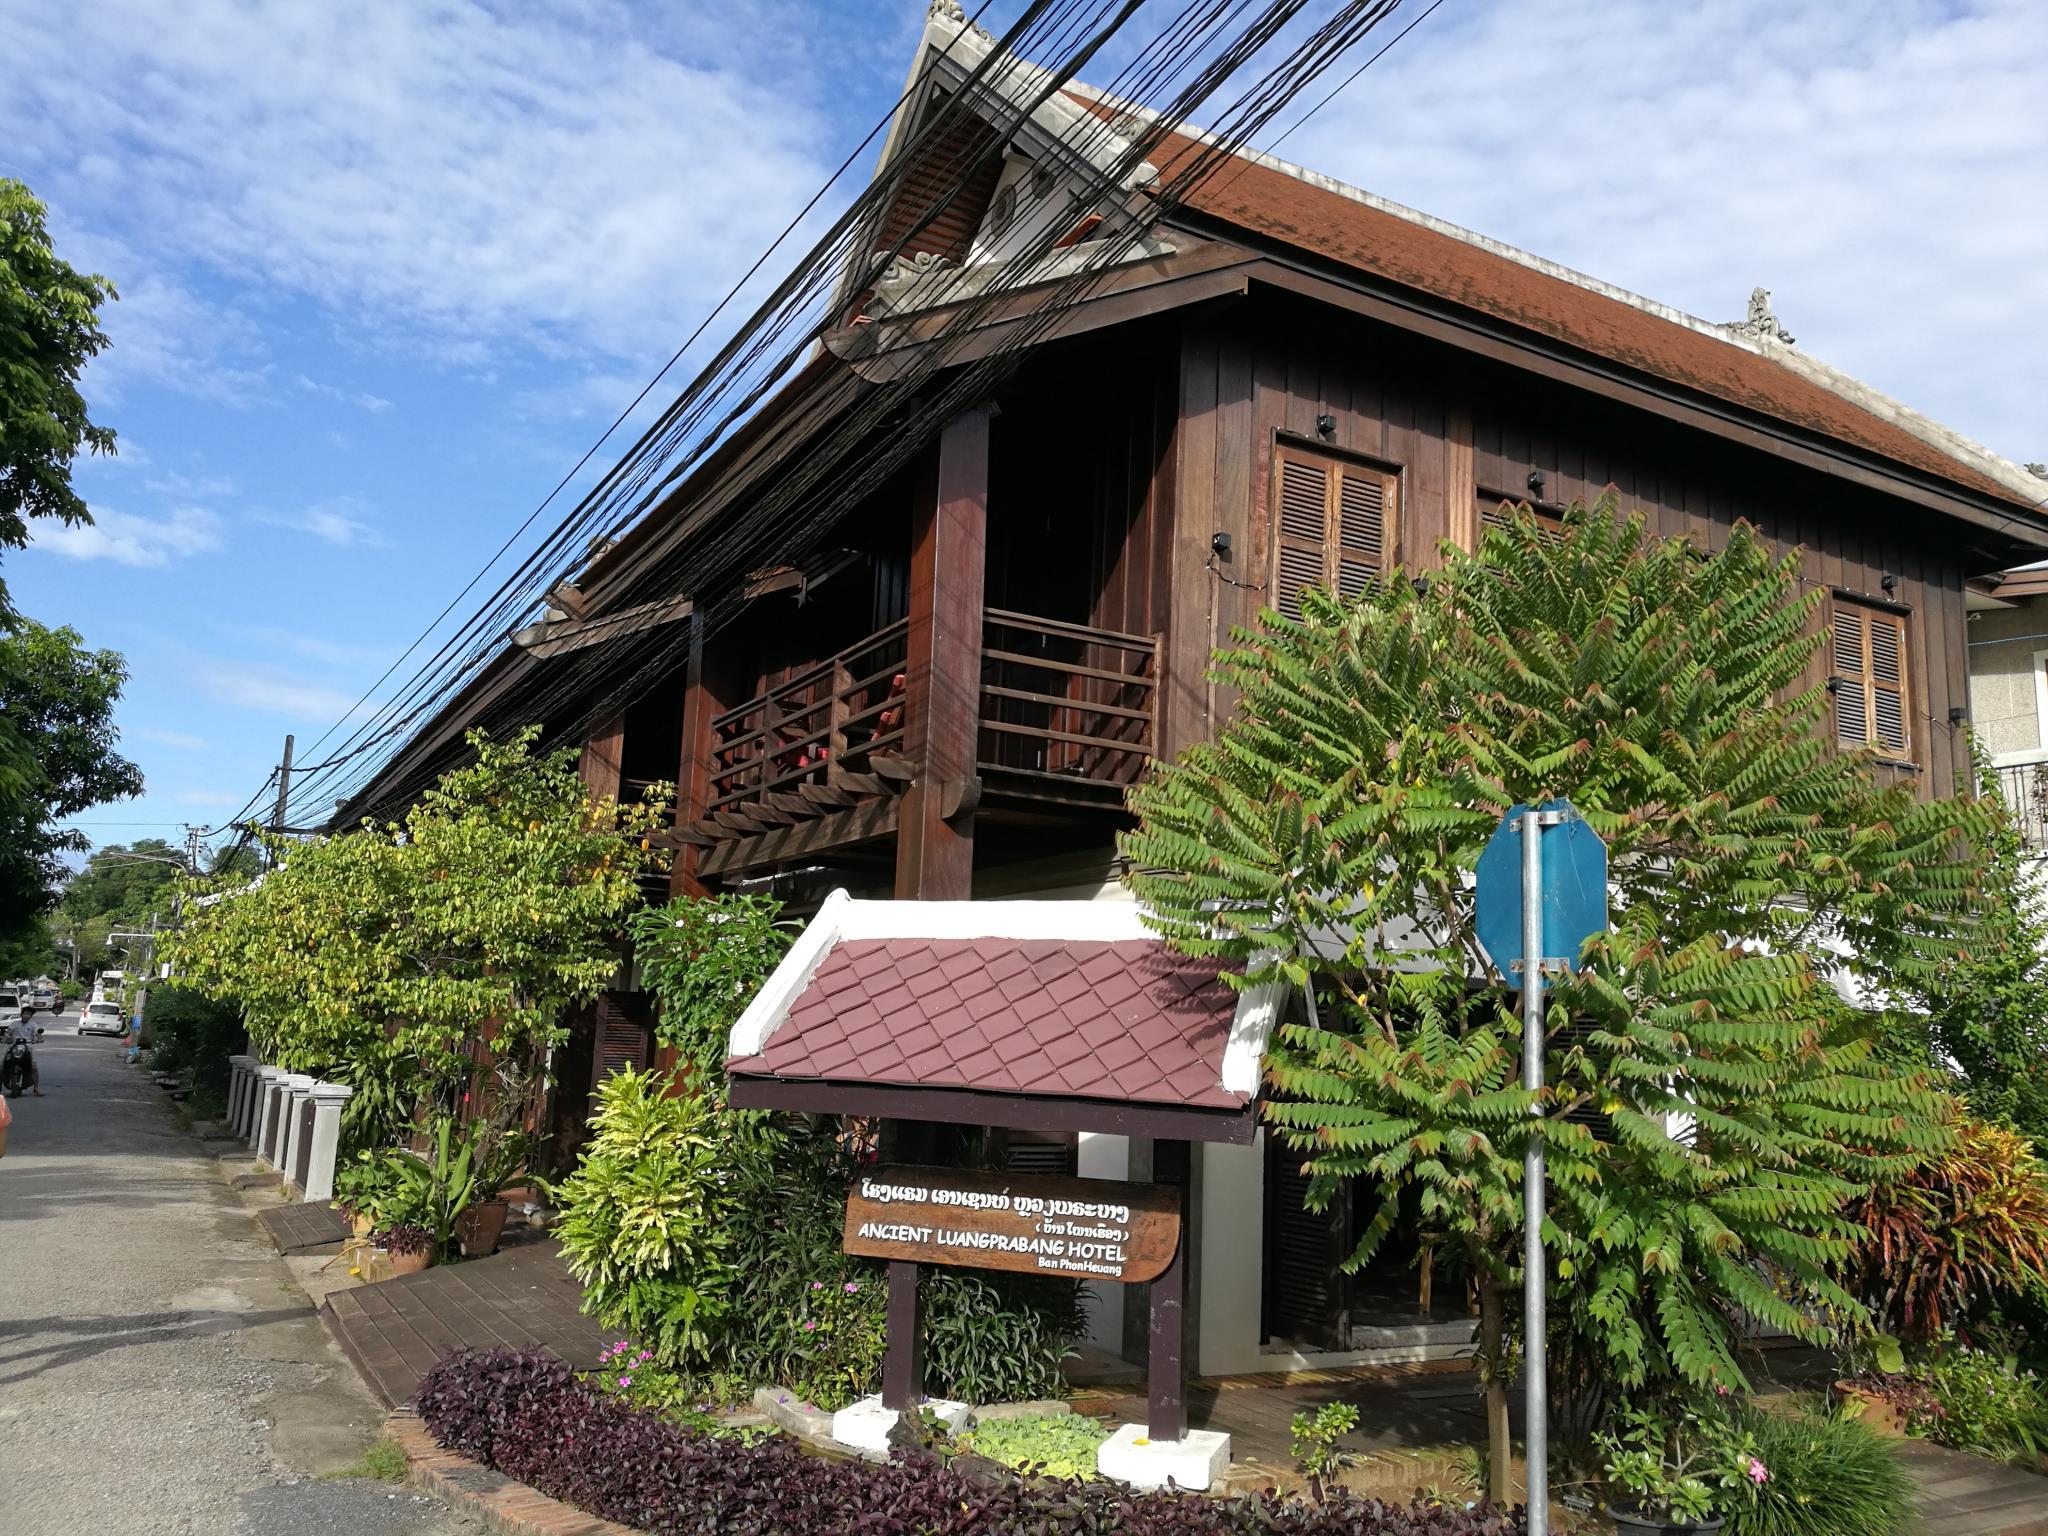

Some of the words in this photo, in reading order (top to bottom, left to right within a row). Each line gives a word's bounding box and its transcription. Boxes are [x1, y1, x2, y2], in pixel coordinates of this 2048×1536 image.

[858, 1223, 932, 1243] ANCIENT
[937, 1229, 1064, 1256] LUANGPRABANG
[1067, 1242, 1128, 1262] HOTEL
[1038, 1256, 1058, 1269] Ban
[1059, 1259, 1122, 1277] PhonHeuang
